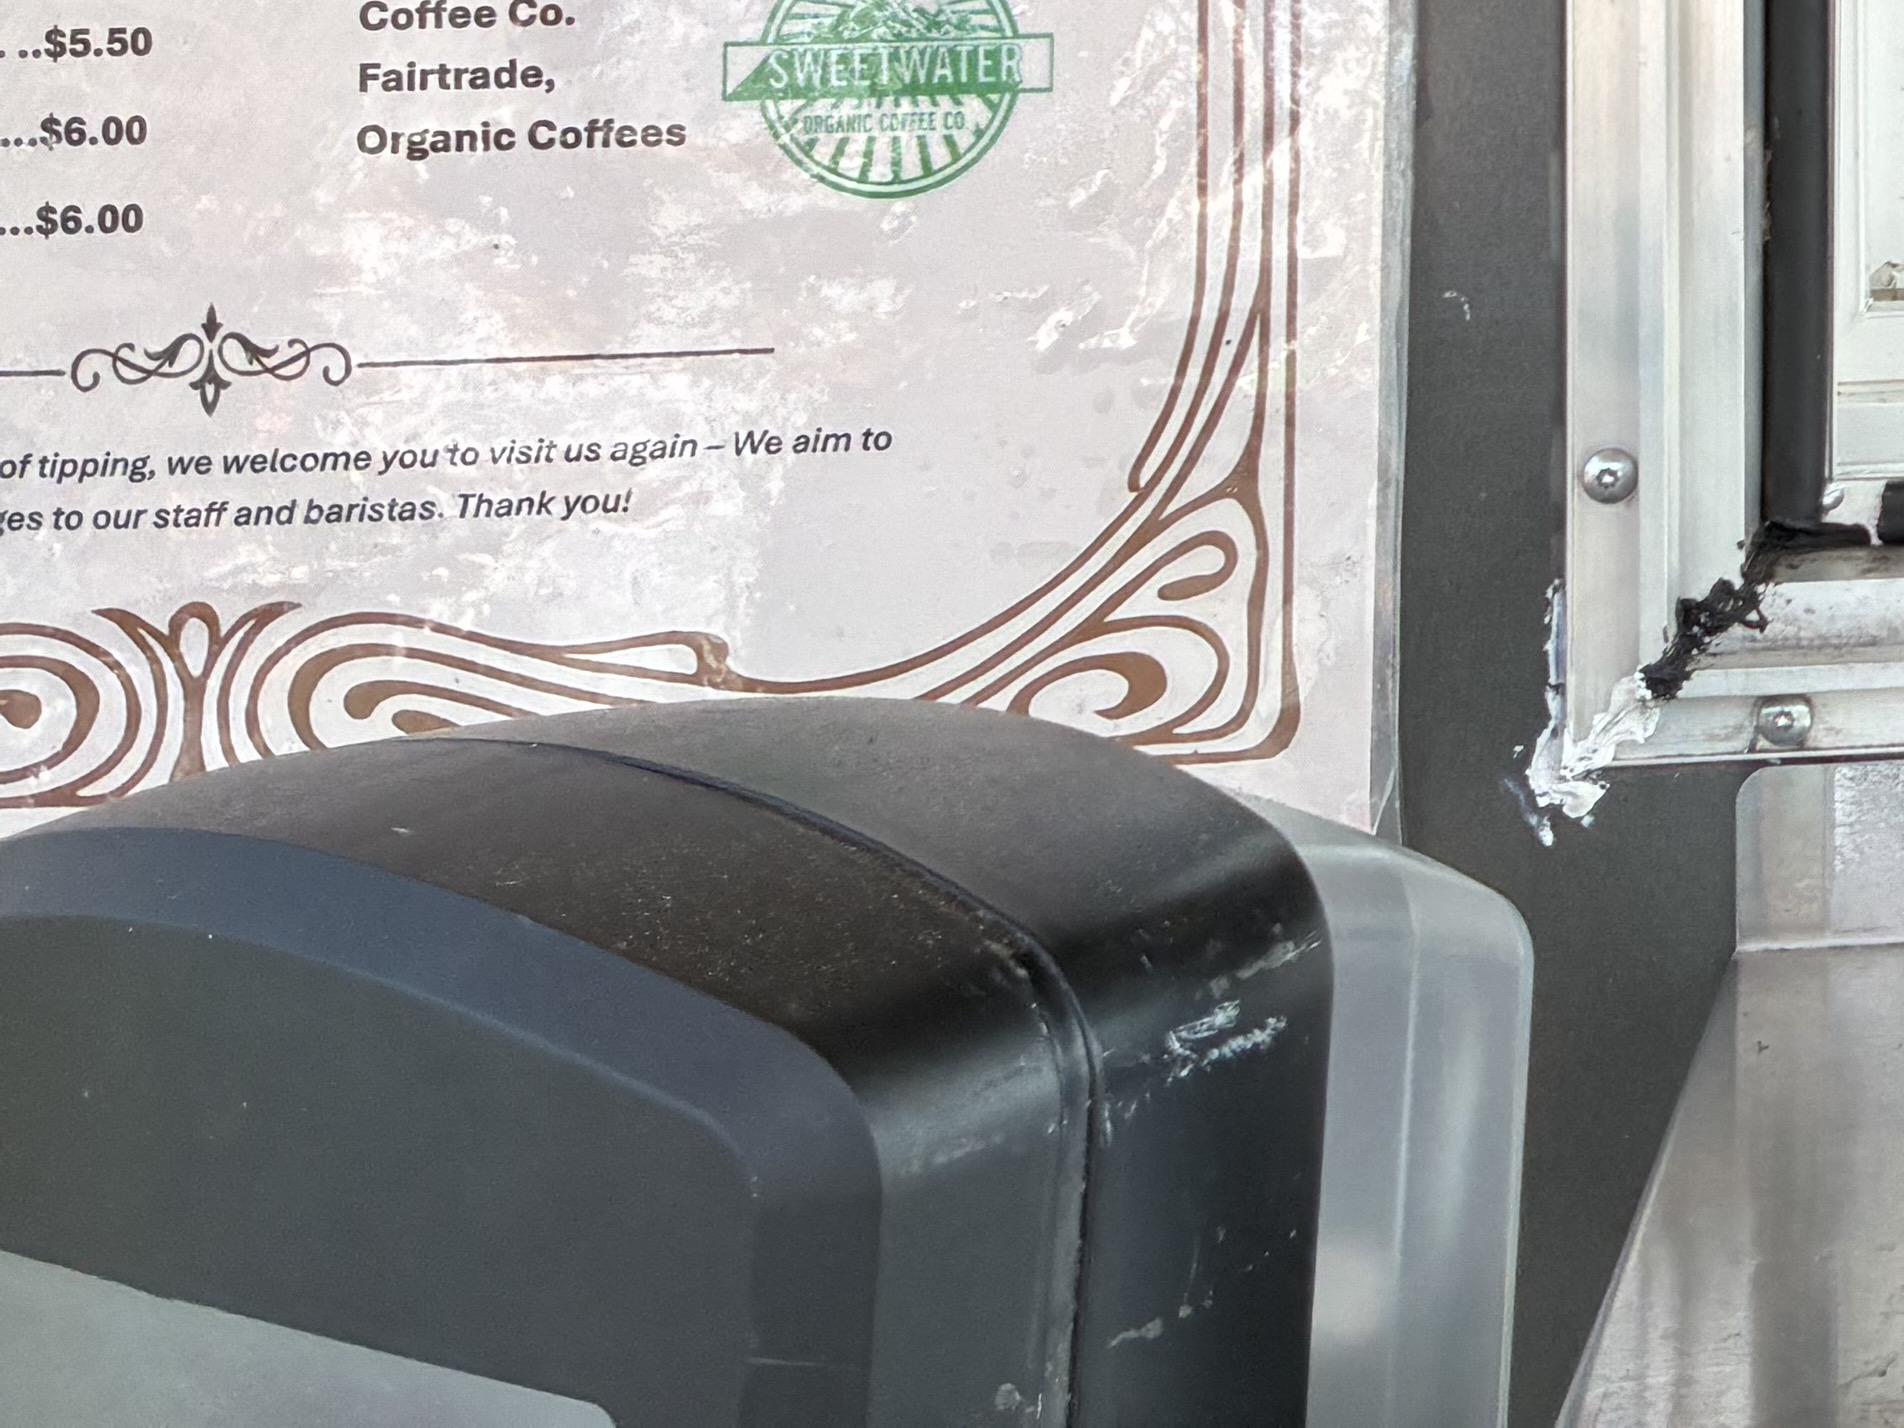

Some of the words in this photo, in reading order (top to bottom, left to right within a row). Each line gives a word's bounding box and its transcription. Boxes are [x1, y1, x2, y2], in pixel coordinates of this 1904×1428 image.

[359, 58, 556, 95] Fairtrade,
[764, 41, 1024, 90] SWEETWATER
[356, 120, 516, 160] Organic
[527, 117, 687, 152] Coffees
[803, 113, 873, 136] ORGANIC
[879, 111, 937, 133] COFFEE
[0, 453, 32, 480] of
[38, 451, 156, 484] tipping,
[167, 454, 212, 476] we
[222, 448, 372, 475] welcome
[377, 447, 437, 476] you
[447, 443, 480, 469] to
[490, 438, 556, 465] visit
[563, 440, 601, 463] us
[610, 433, 698, 468] again
[733, 430, 783, 457] We
[792, 428, 852, 455] aim
[862, 427, 893, 452] to
[53, 507, 84, 531] to
[92, 509, 148, 530] our
[153, 501, 228, 529] staff
[234, 499, 296, 526] and
[303, 496, 445, 526] baristas.
[457, 490, 556, 519] Thank
[560, 488, 633, 521] you!
